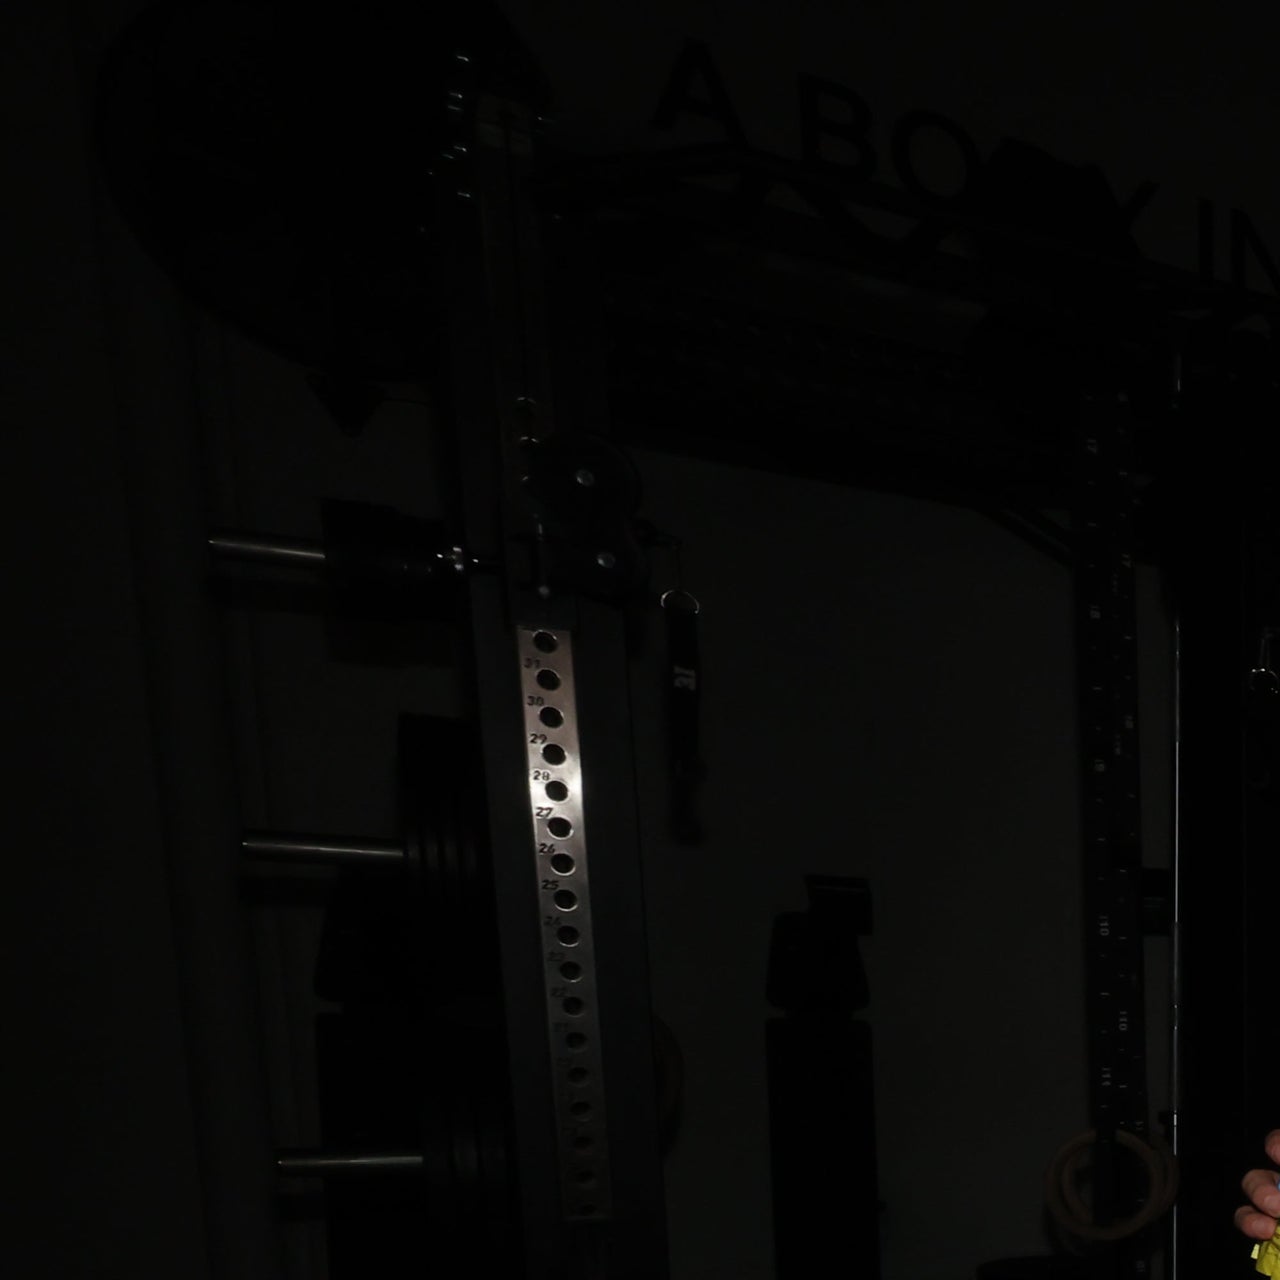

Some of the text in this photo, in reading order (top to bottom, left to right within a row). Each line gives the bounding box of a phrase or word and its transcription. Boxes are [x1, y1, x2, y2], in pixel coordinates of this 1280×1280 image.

[650, 37, 750, 148] A
[797, 71, 1161, 250] BO
[529, 733, 547, 745] 29
[533, 770, 550, 781] 28
[535, 807, 553, 818] 27
[538, 843, 556, 854] 26
[541, 879, 559, 890] 25
